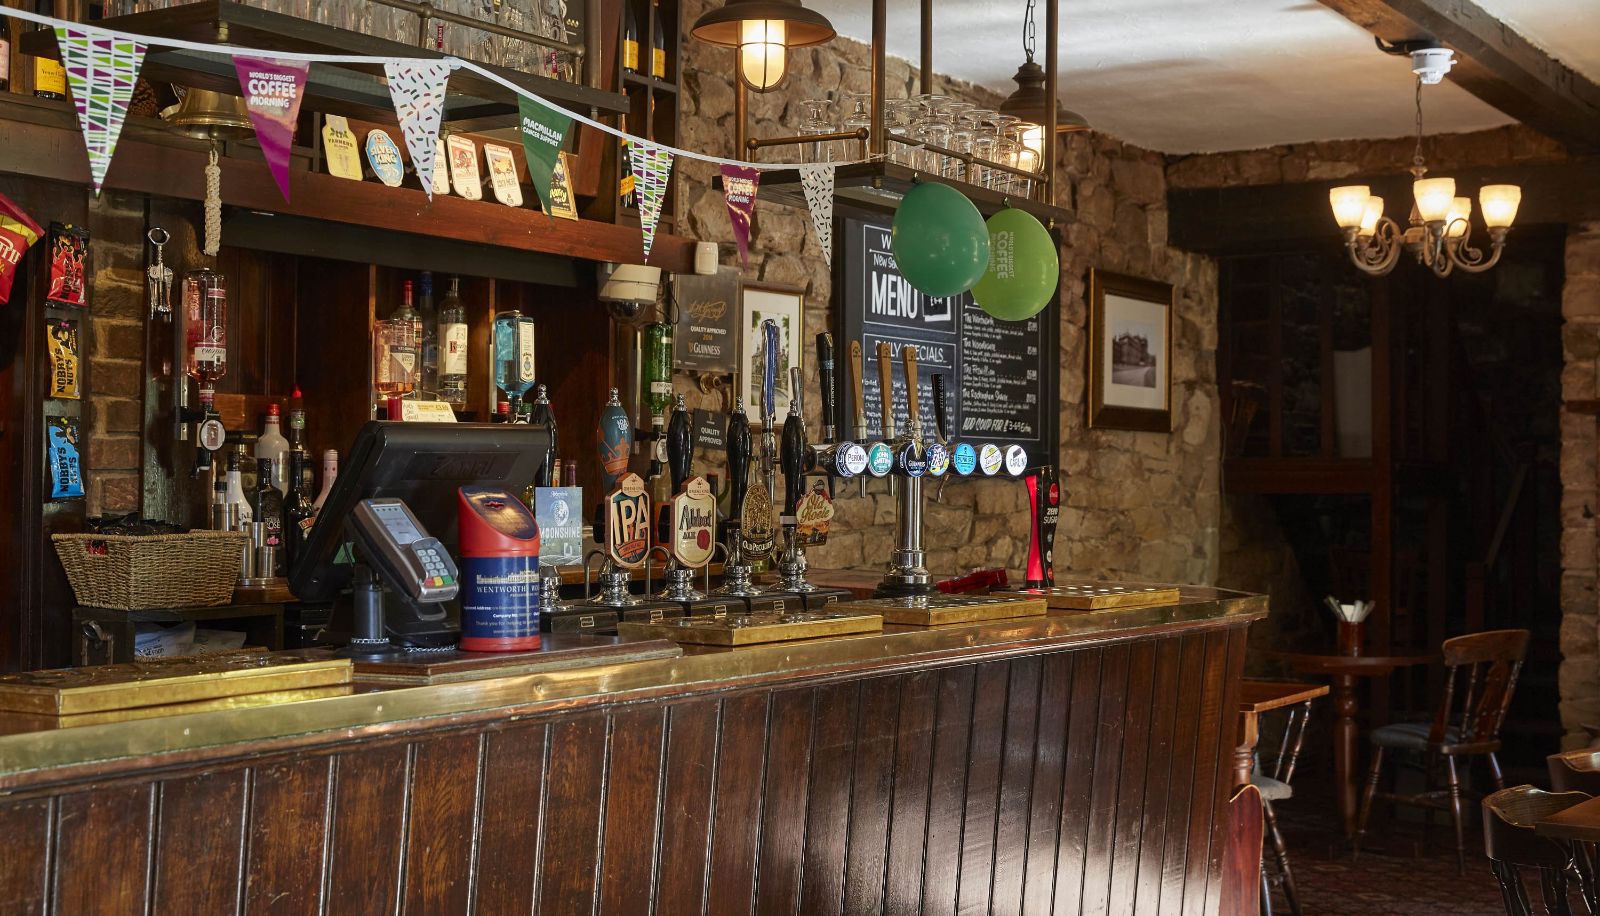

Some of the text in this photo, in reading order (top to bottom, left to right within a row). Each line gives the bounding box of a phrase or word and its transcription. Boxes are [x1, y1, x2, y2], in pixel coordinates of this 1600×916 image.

[249, 71, 295, 82] WORLD'S BIGGEST
[248, 79, 296, 98] COFFEE
[250, 96, 289, 108] MORNING
[523, 116, 562, 141] MACMILLAN
[522, 127, 558, 147] CANCER SUPPORT
[371, 146, 395, 156] SILVER
[374, 154, 396, 165] KING
[873, 254, 887, 267] New
[997, 231, 1008, 279] COFFEE
[871, 271, 918, 319] MENU
[706, 327, 727, 335] APPROVED
[693, 342, 721, 356] GUINNESS
[65, 359, 74, 385] NUTS
[700, 426, 720, 436] QUALITY
[698, 435, 723, 446] APPROVED
[611, 495, 649, 545] IPA
[679, 505, 712, 531] Abbot
[540, 526, 581, 538] MOONSHINE
